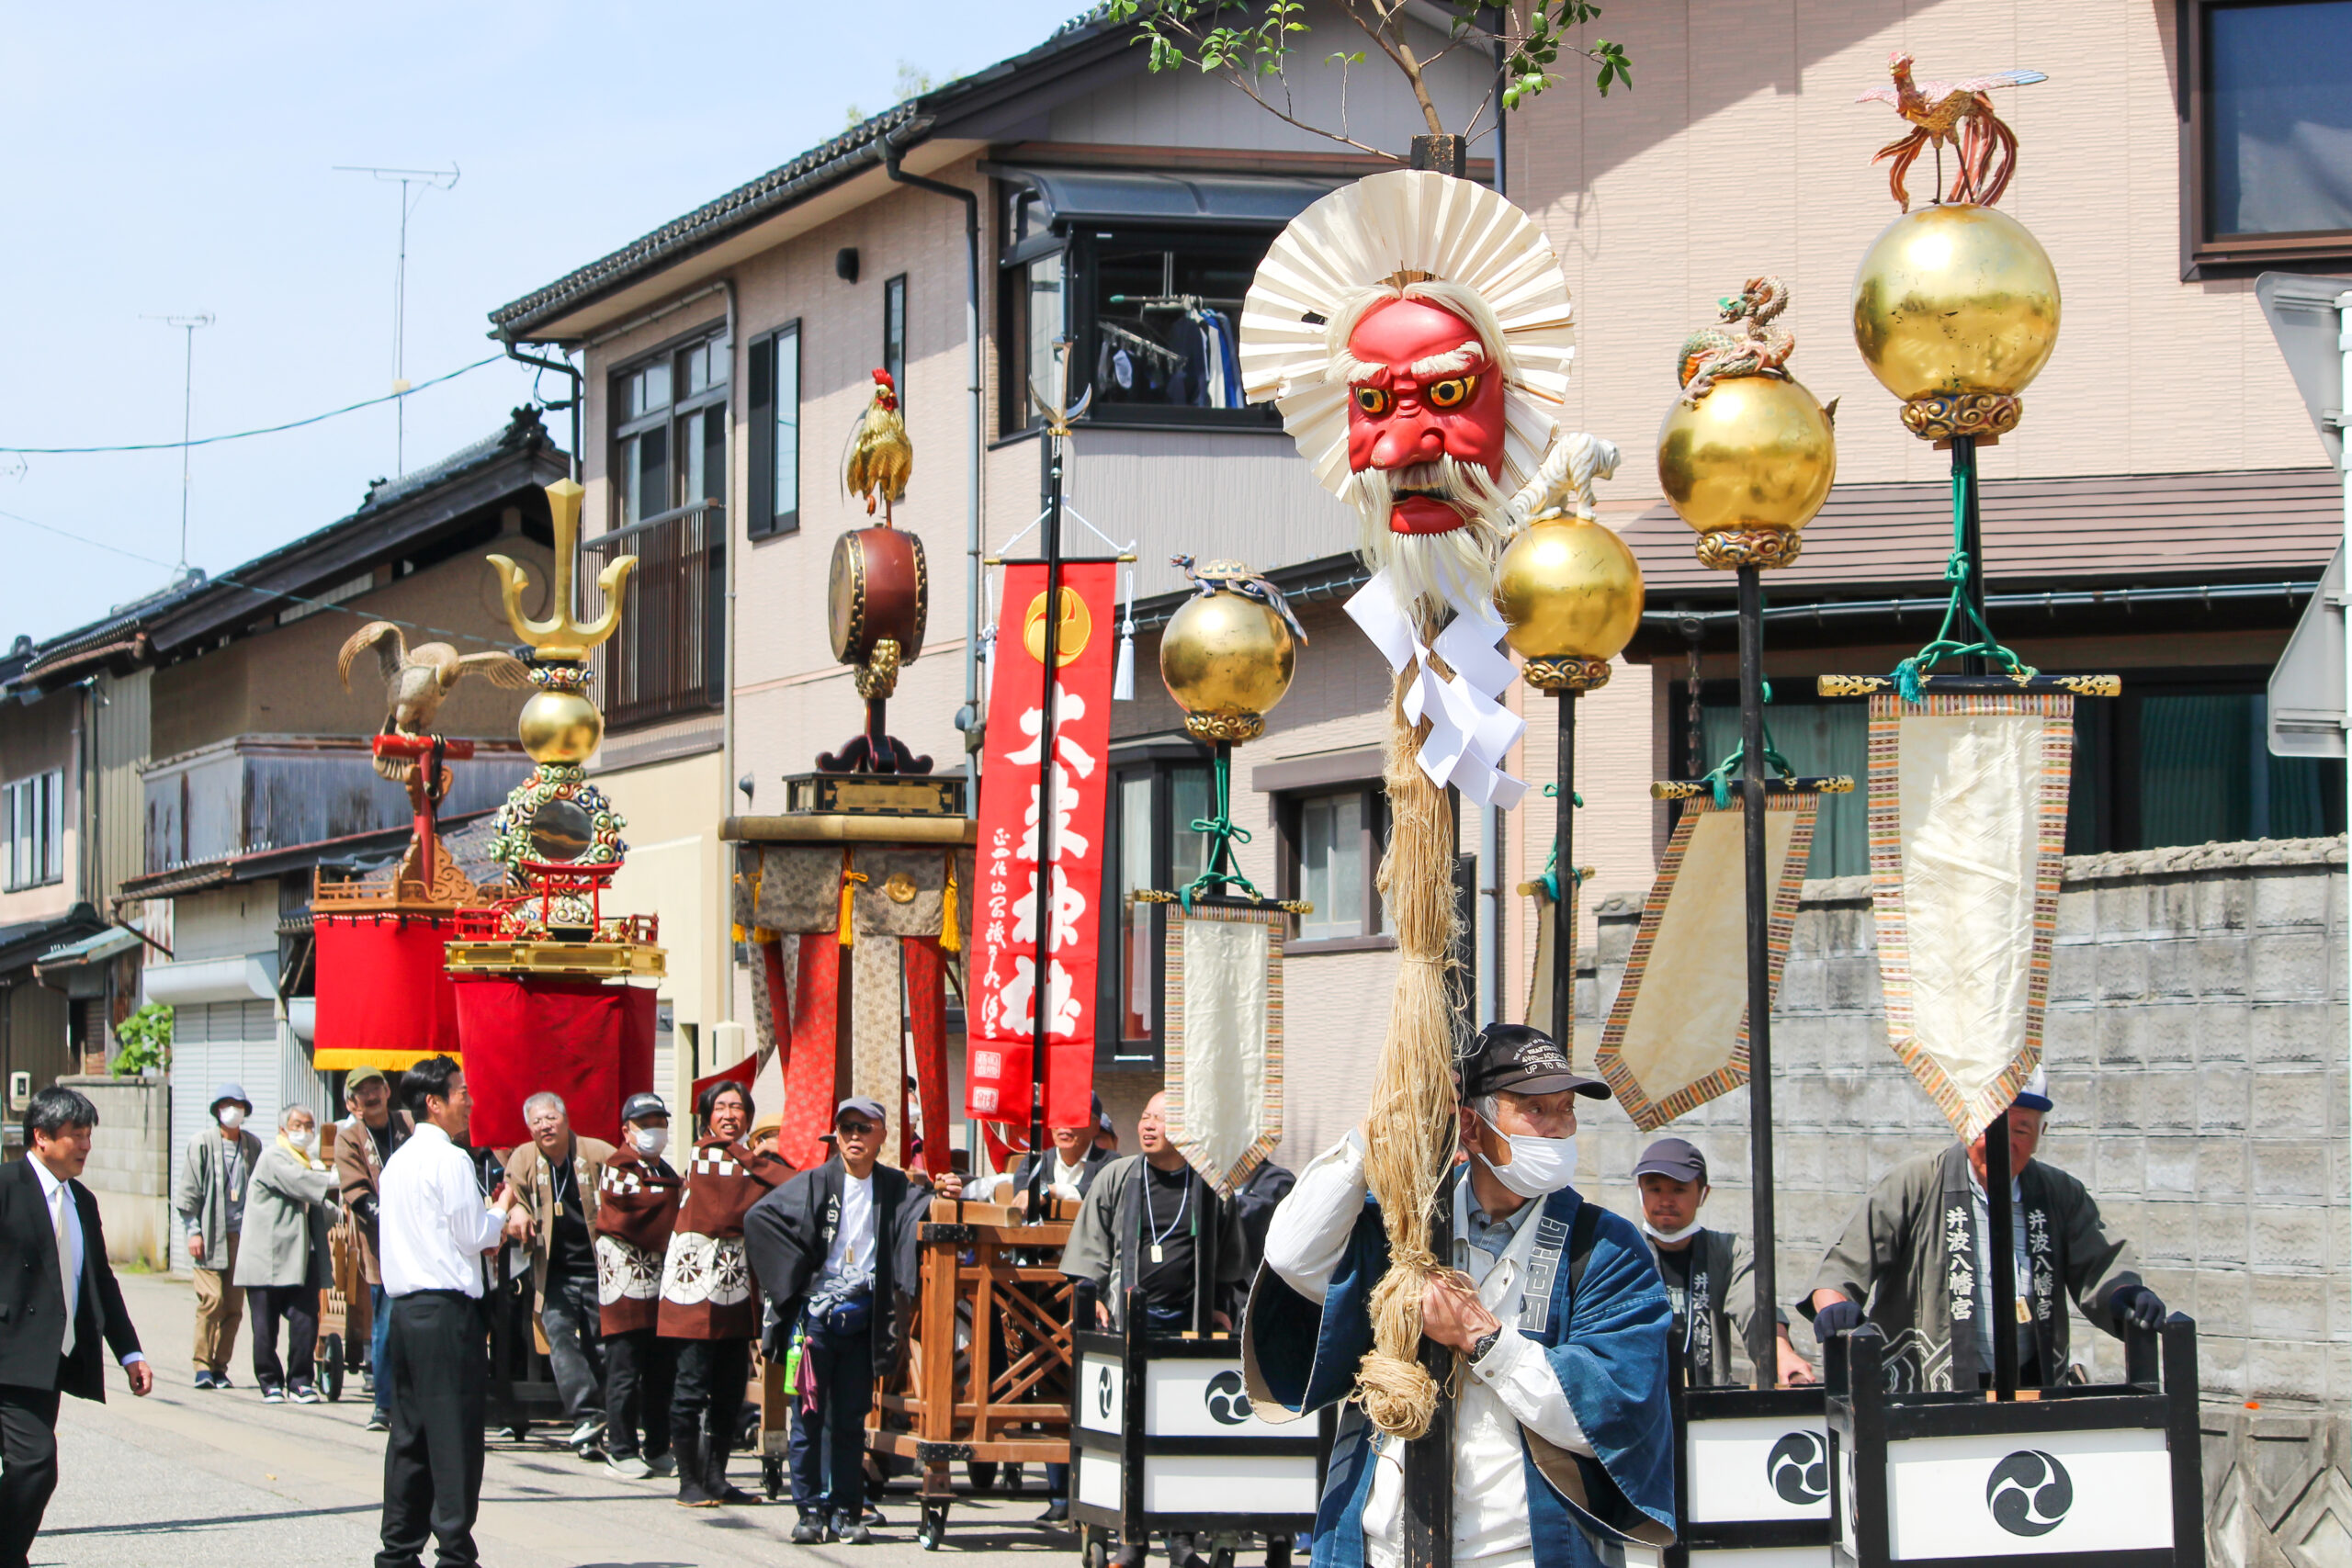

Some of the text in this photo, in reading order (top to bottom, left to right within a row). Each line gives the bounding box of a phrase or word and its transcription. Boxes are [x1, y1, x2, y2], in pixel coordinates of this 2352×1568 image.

[1524, 1064, 1538, 1075] UP
[1543, 1062, 1554, 1070] TO
[1945, 1205, 1976, 1321] 井波八幡宮
[2027, 1208, 2054, 1322] 井波八幡宮
[1693, 1271, 1712, 1367] 井波八幡宮
